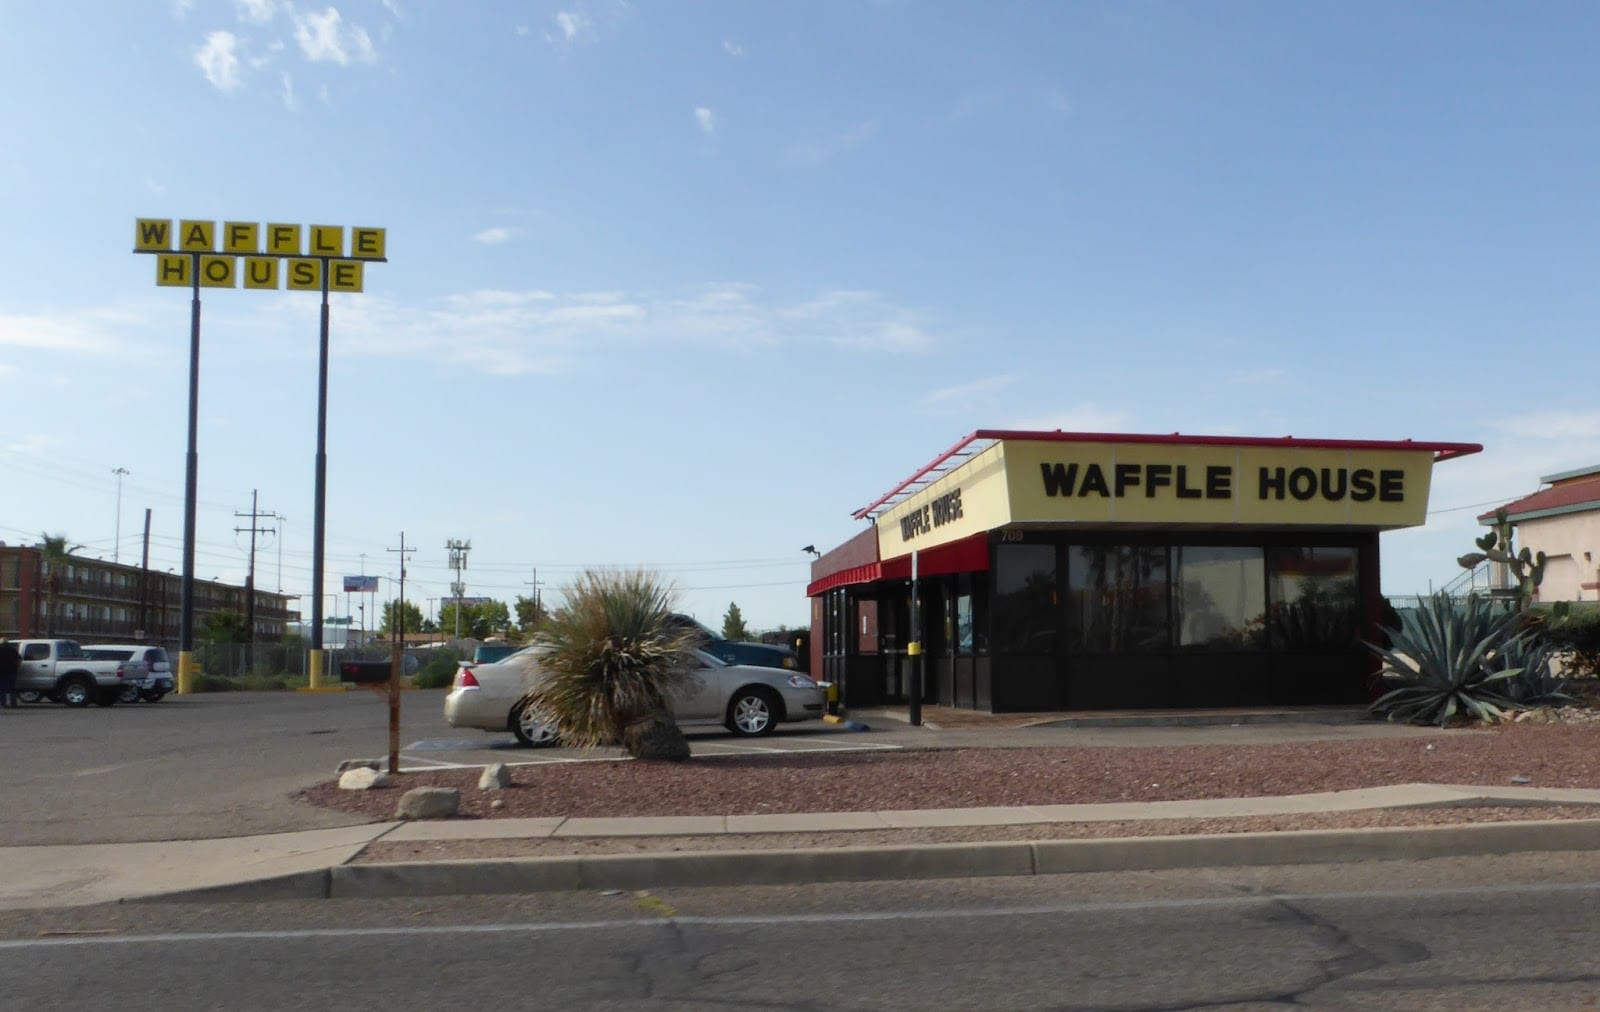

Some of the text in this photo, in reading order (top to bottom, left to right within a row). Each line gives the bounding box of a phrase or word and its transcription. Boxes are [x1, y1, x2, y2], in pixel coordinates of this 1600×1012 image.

[140, 222, 377, 253] WAFFLE
[162, 258, 355, 286] HOUSE
[1041, 463, 1404, 502] WAFFLE HOUSE
[900, 488, 963, 542] WAFFLE HOUSE
